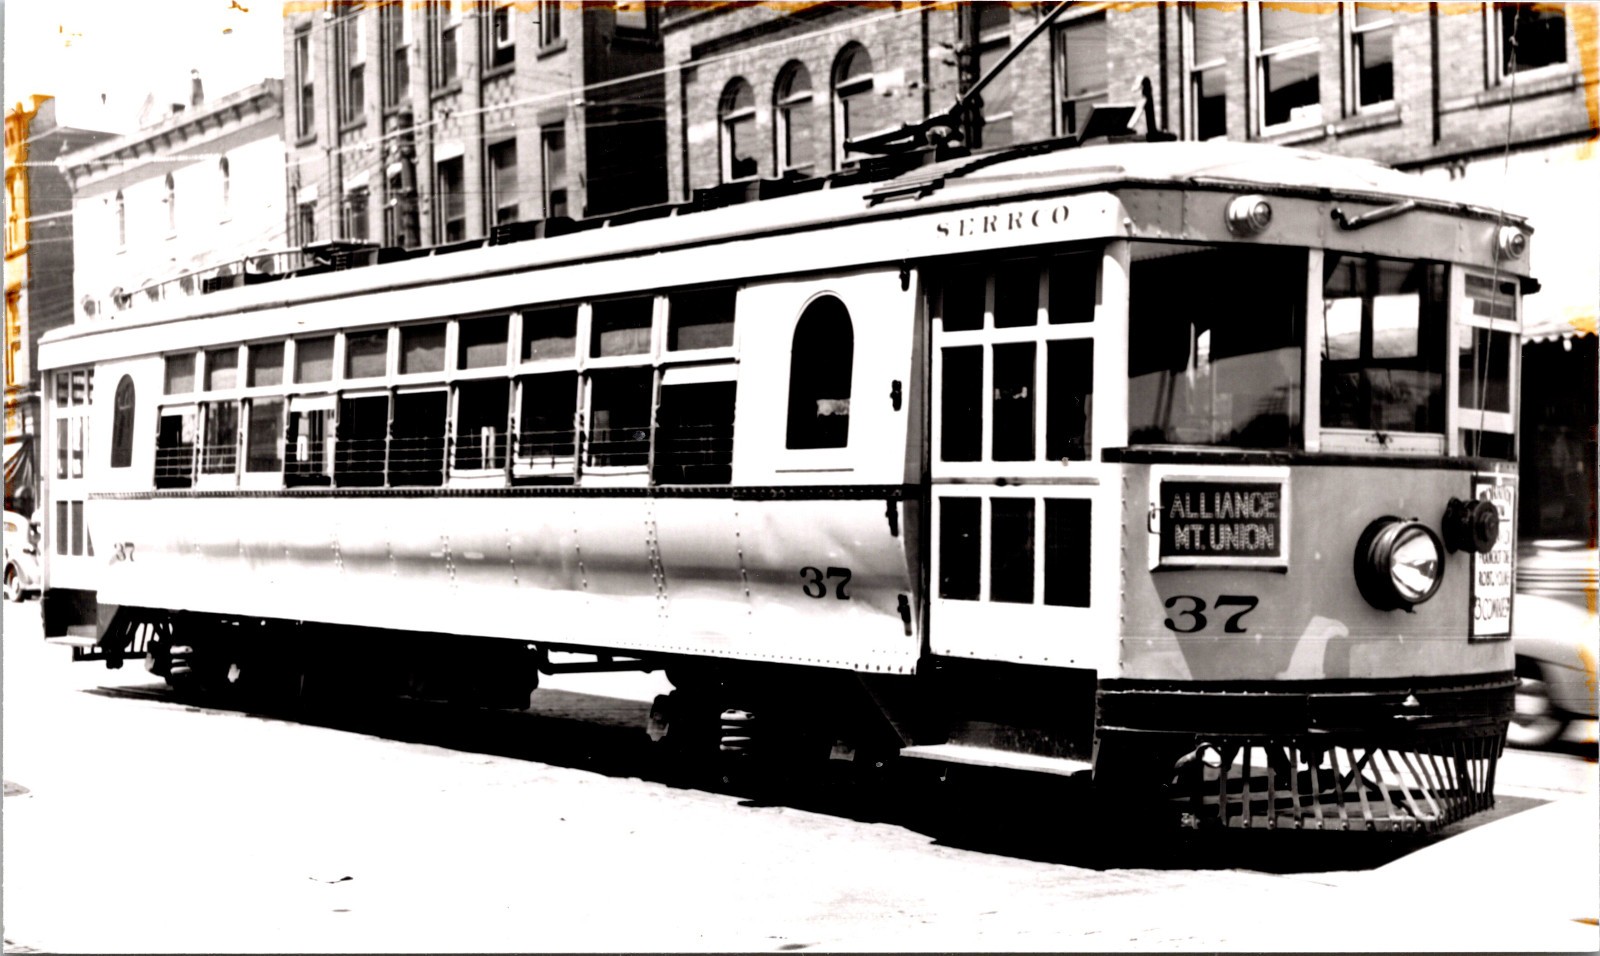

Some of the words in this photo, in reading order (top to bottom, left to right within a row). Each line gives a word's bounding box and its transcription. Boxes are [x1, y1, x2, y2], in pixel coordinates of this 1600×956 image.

[937, 205, 1069, 238] SERRCO
[1169, 491, 1279, 519] ALLIANCE
[1174, 523, 1206, 550] MT.
[1209, 523, 1275, 550] UNION
[113, 542, 135, 562] 37
[800, 566, 852, 600] 37
[1164, 594, 1259, 633] 37
